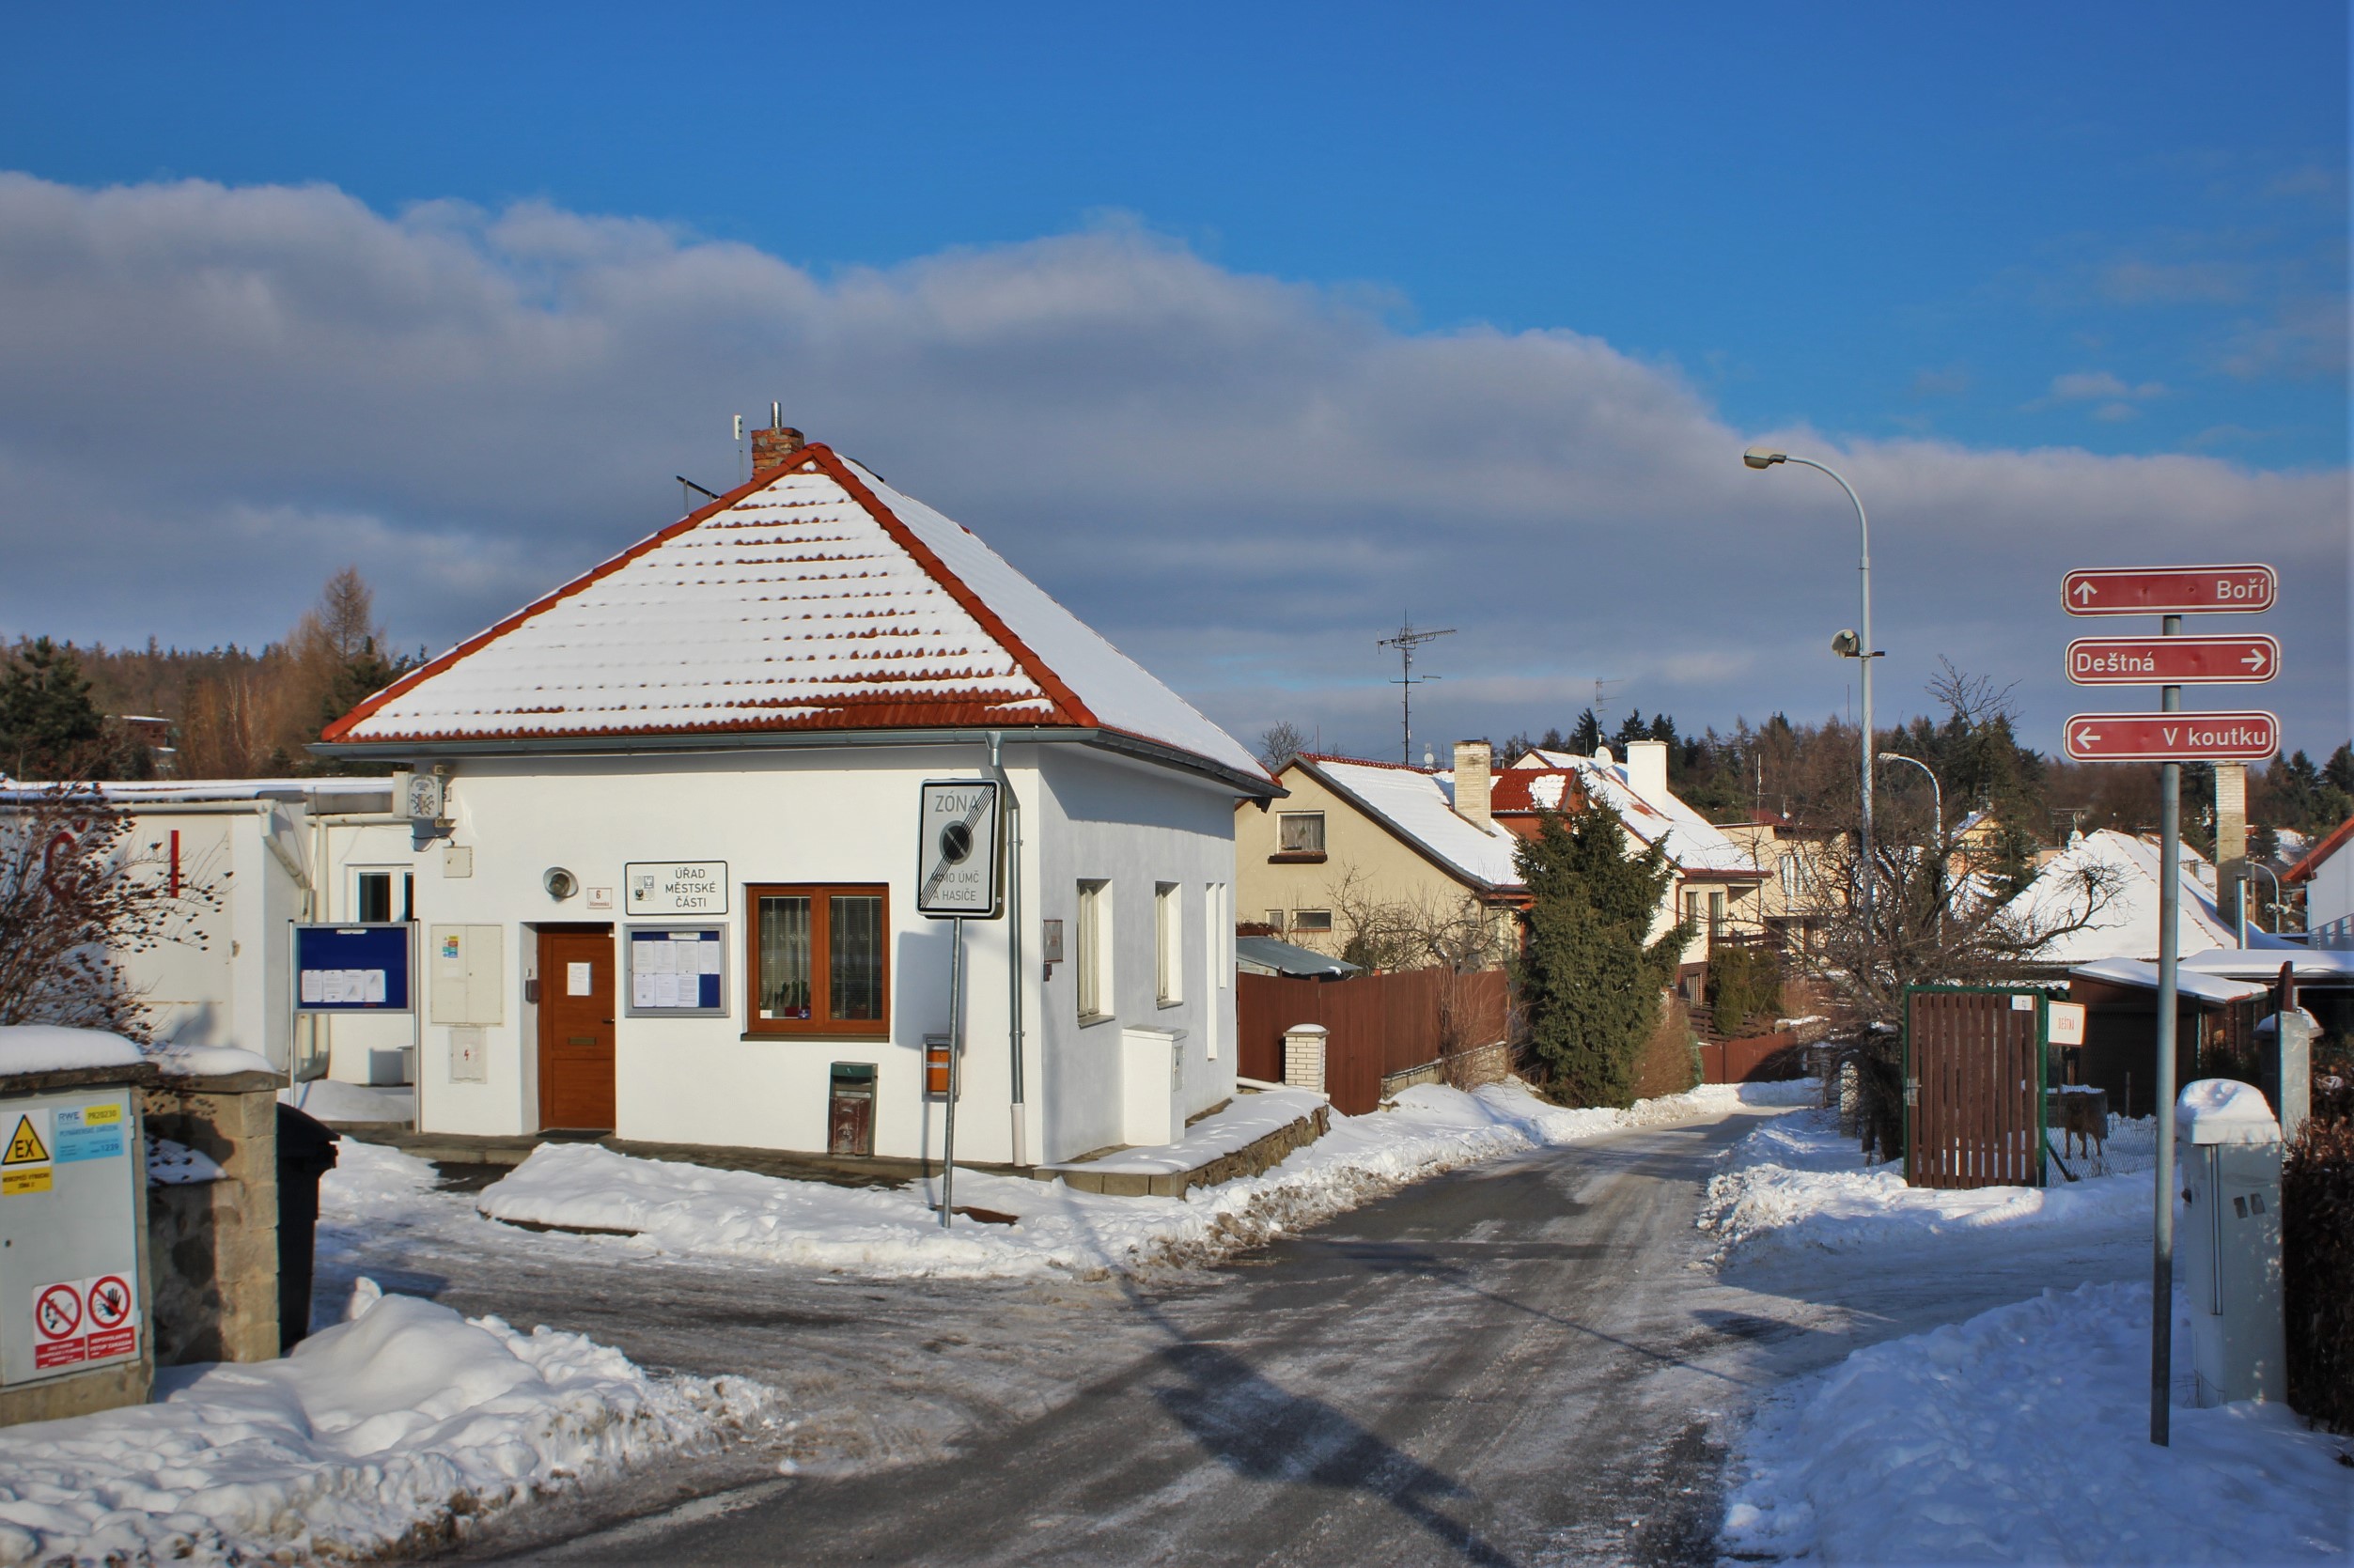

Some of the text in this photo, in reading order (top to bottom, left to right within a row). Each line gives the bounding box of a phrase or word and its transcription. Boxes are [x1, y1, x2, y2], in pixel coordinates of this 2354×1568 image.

[2217, 578, 2266, 599] Boří
[2076, 650, 2155, 673] Deštná
[2162, 726, 2267, 747] V koutku
[935, 790, 979, 812] ZÓNA
[675, 866, 706, 879] ÚŘAD
[959, 870, 979, 884] ÚMČ
[665, 880, 716, 893] MĚSTSKÉ
[596, 890, 601, 899] 6
[943, 888, 976, 901] HASIČE
[676, 895, 707, 908] ČÁSTI
[59, 1111, 80, 1121] RWE
[15, 1139, 35, 1158] EX
